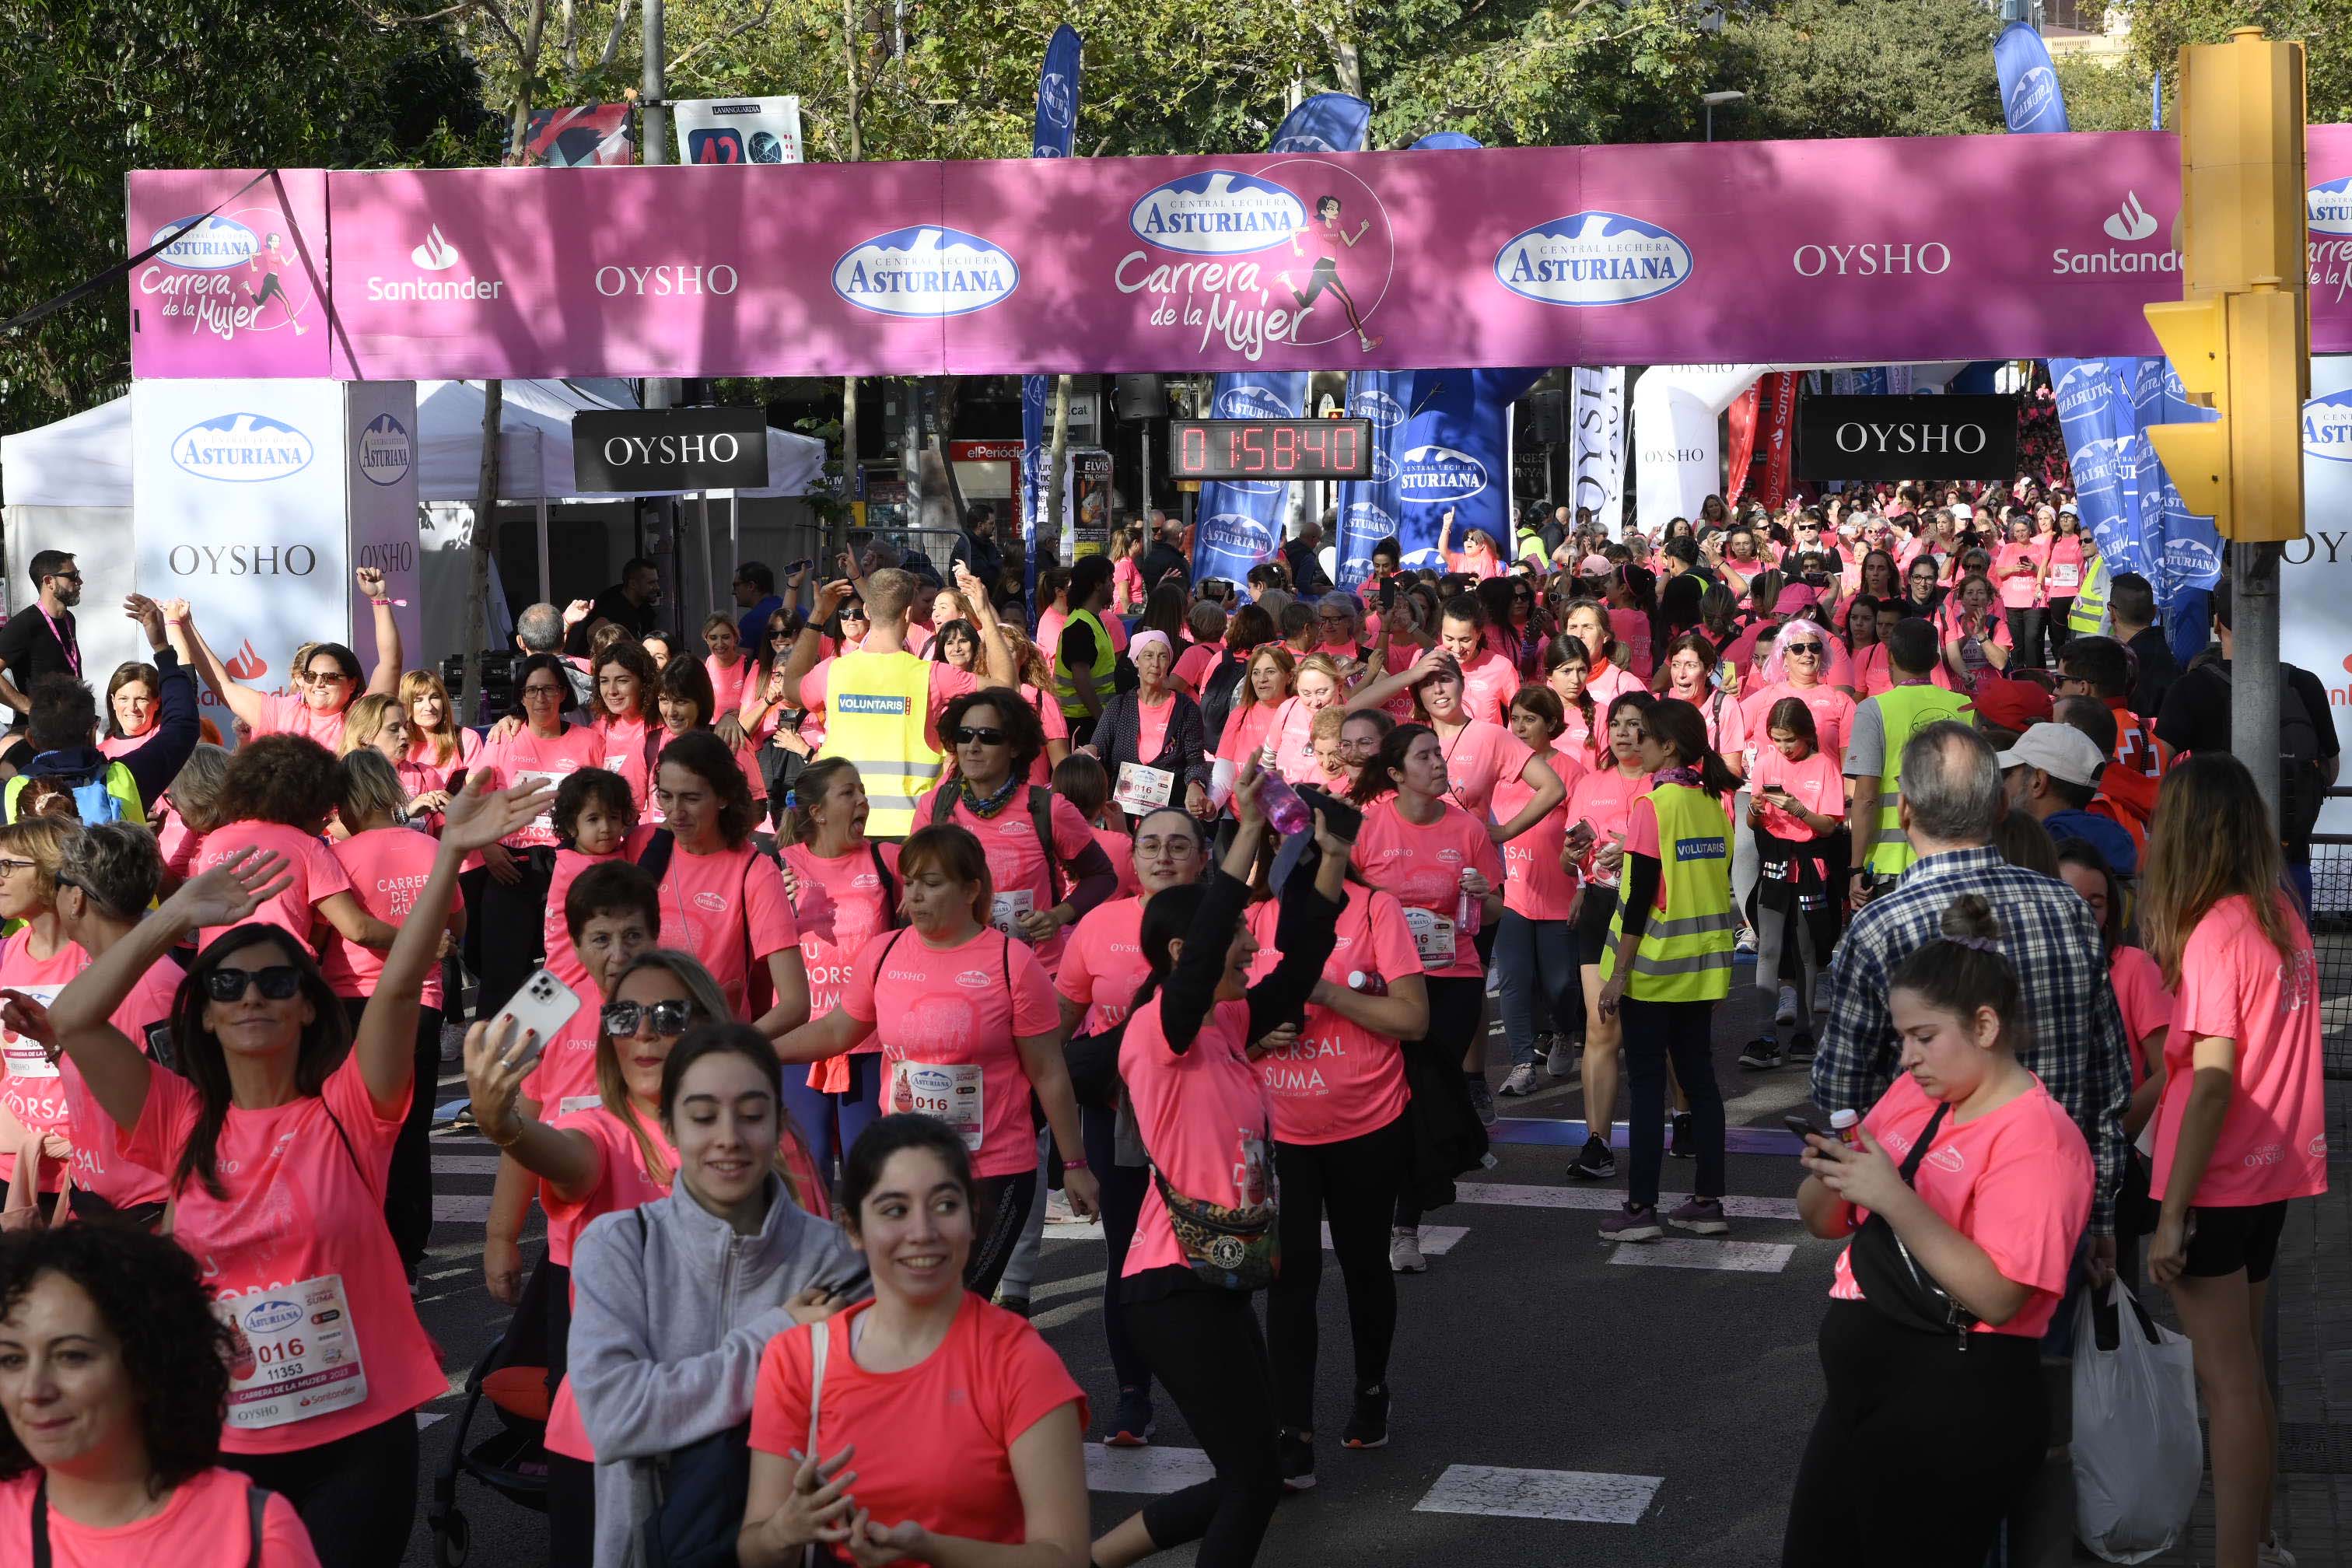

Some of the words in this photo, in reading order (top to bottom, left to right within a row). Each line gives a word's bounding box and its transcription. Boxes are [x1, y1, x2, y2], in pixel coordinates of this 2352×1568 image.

[1171, 199, 1226, 208] CENTRAL
[1232, 198, 1289, 208] LECHERA
[1143, 202, 1293, 235] ASTURIANA
[1540, 245, 1601, 255] CENTRAL
[1608, 243, 1671, 253] LECHERA
[1793, 242, 1951, 277] OYSHO
[846, 260, 1005, 293] ASTURIANA
[1115, 250, 1260, 294] Carrera
[1510, 248, 1678, 282] ASTURIANA
[140, 265, 232, 295] Carrera
[368, 275, 503, 301] Santander
[595, 264, 738, 296] OYSHO
[162, 299, 179, 317] de
[183, 296, 195, 317] la
[193, 292, 265, 341] Mujer
[1150, 295, 1177, 327] de
[1183, 294, 1203, 327] la
[1199, 287, 1315, 362] Mujer
[1225, 396, 1286, 418] ASTURIA
[604, 432, 739, 466] OYSHO
[1183, 427, 1356, 471] 01:58:40
[1836, 422, 1986, 454] OYSHO
[183, 439, 303, 465] ASTURIANA
[362, 440, 408, 468] ASTURIANA
[1644, 448, 1704, 463] OYSHO
[1085, 460, 1108, 471] ELVIS
[1205, 524, 1268, 552] ASTURIANA
[169, 544, 317, 576] OYSHO
[359, 541, 412, 574] OYSHO
[840, 698, 903, 711] VOLUNTARIS
[1384, 848, 1413, 857] OYSHO
[696, 898, 725, 909] ASTURIANA
[887, 970, 926, 982] OYSHO
[957, 975, 989, 985] ASTURIANA
[912, 1076, 950, 1088] ASTURIANA
[1265, 1066, 1326, 1090] SUMA
[915, 1097, 948, 1111] 016
[2245, 1153, 2284, 1167] OYSHO
[306, 1293, 334, 1306] SUMA
[249, 1310, 299, 1329] ASTURIANA
[259, 1338, 305, 1363] 016
[240, 1386, 274, 1401] CARRERA
[283, 1382, 296, 1392] LA
[298, 1374, 327, 1391] MUJER
[330, 1368, 348, 1380] 2023
[268, 1363, 303, 1381] 11353
[312, 1384, 356, 1405] Santander
[237, 1404, 278, 1421] OYSHO
